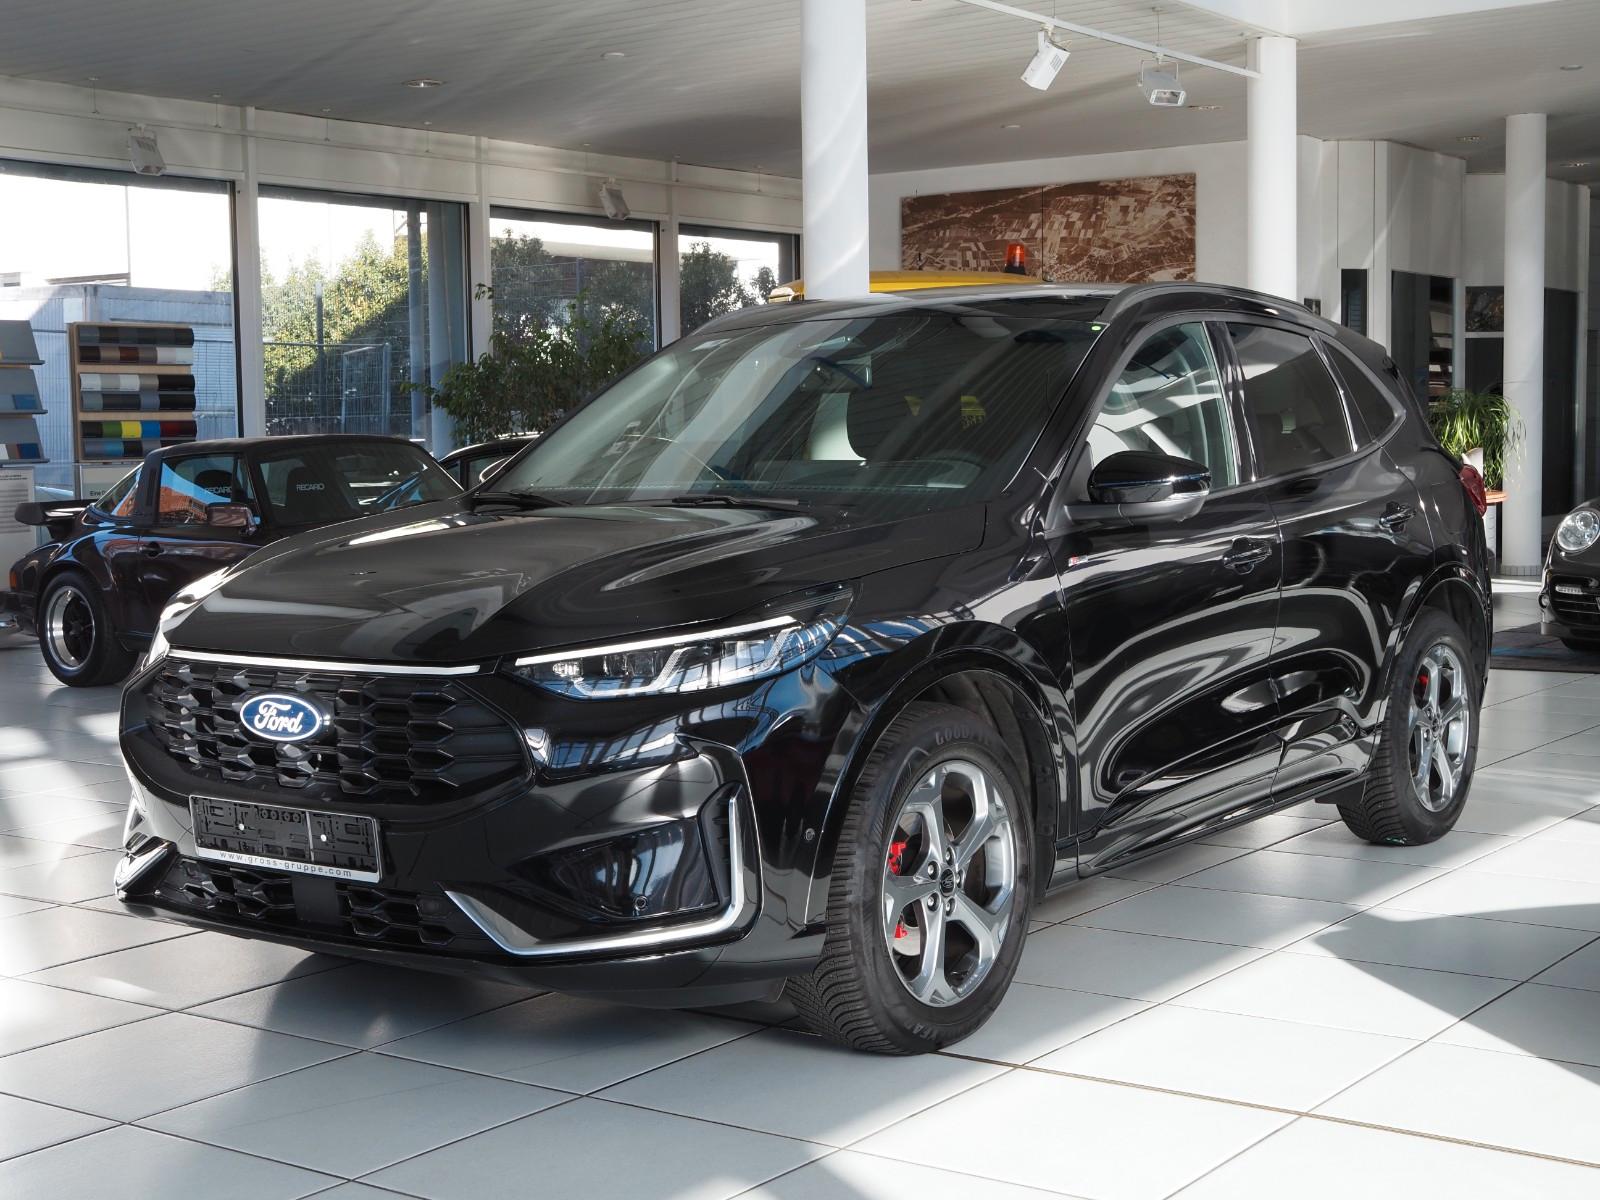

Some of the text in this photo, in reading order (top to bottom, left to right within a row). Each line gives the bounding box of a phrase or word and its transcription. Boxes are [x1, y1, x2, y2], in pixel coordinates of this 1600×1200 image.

[295, 482, 325, 492] RECARO
[253, 700, 304, 734] Ford
[219, 851, 352, 878] www.gross-gruppe.com
